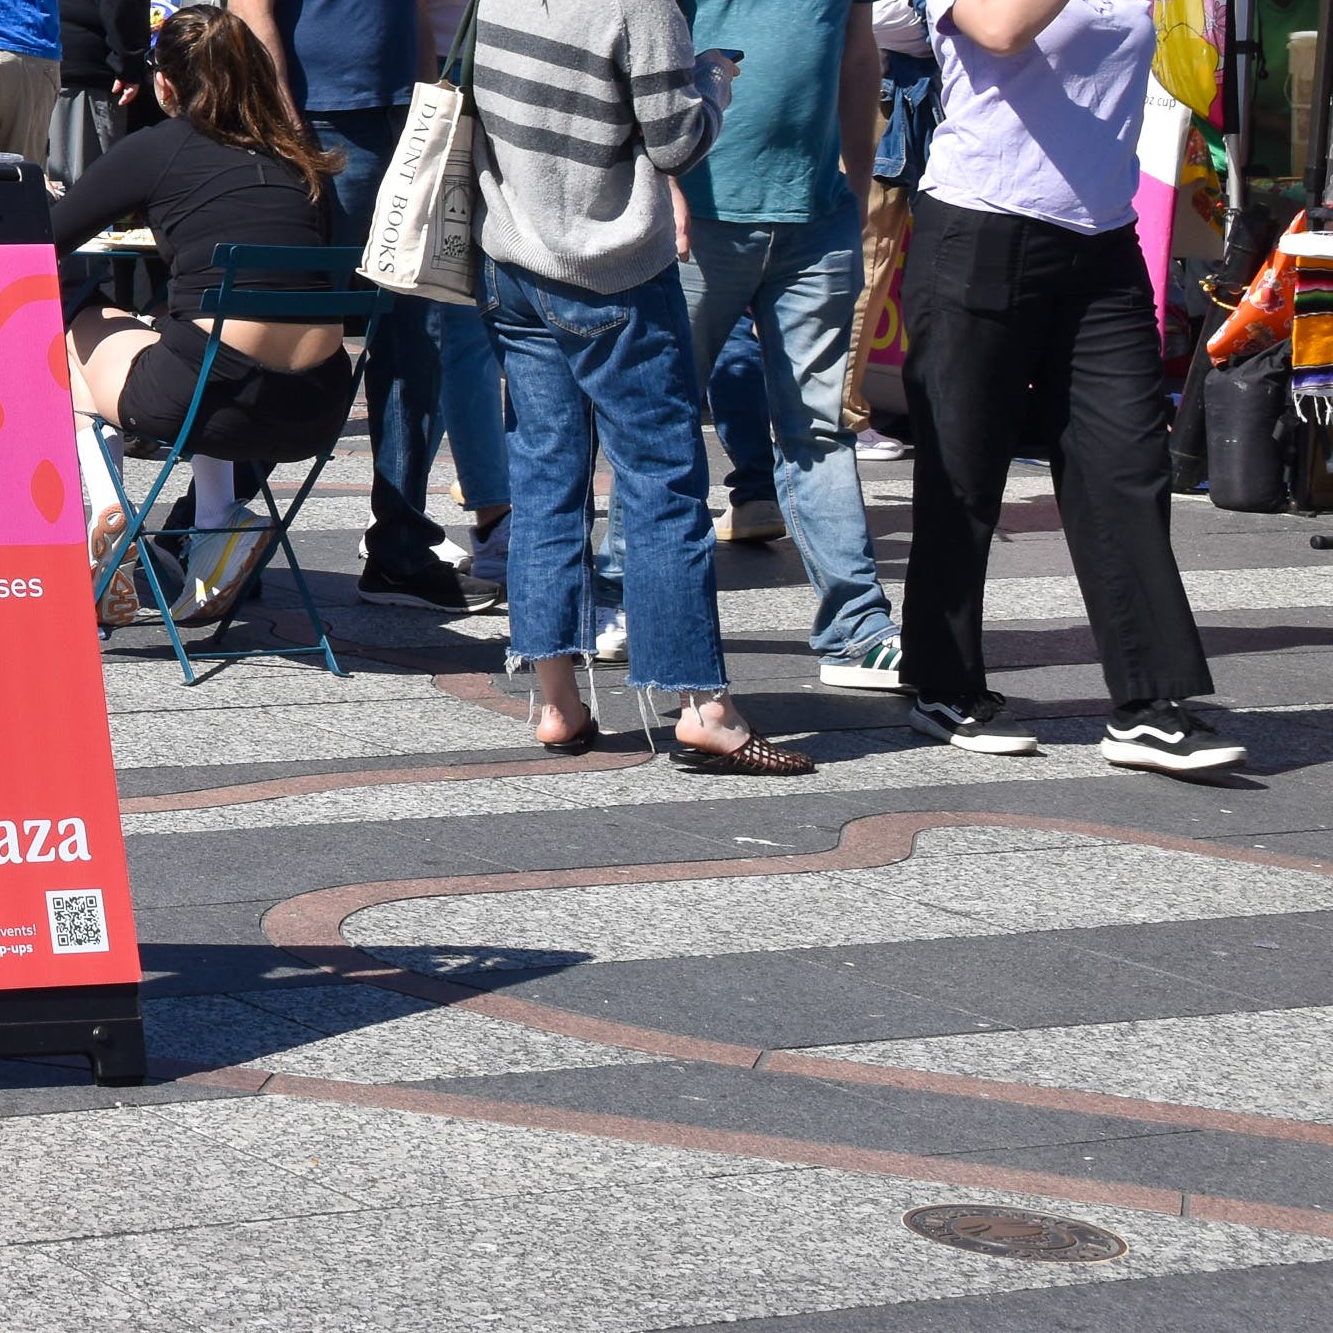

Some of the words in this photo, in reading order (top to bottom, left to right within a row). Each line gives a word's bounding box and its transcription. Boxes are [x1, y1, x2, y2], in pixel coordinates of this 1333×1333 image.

[1157, 97, 1177, 110] cup
[399, 103, 437, 185] DAUNT
[378, 194, 408, 274] BOOKS
